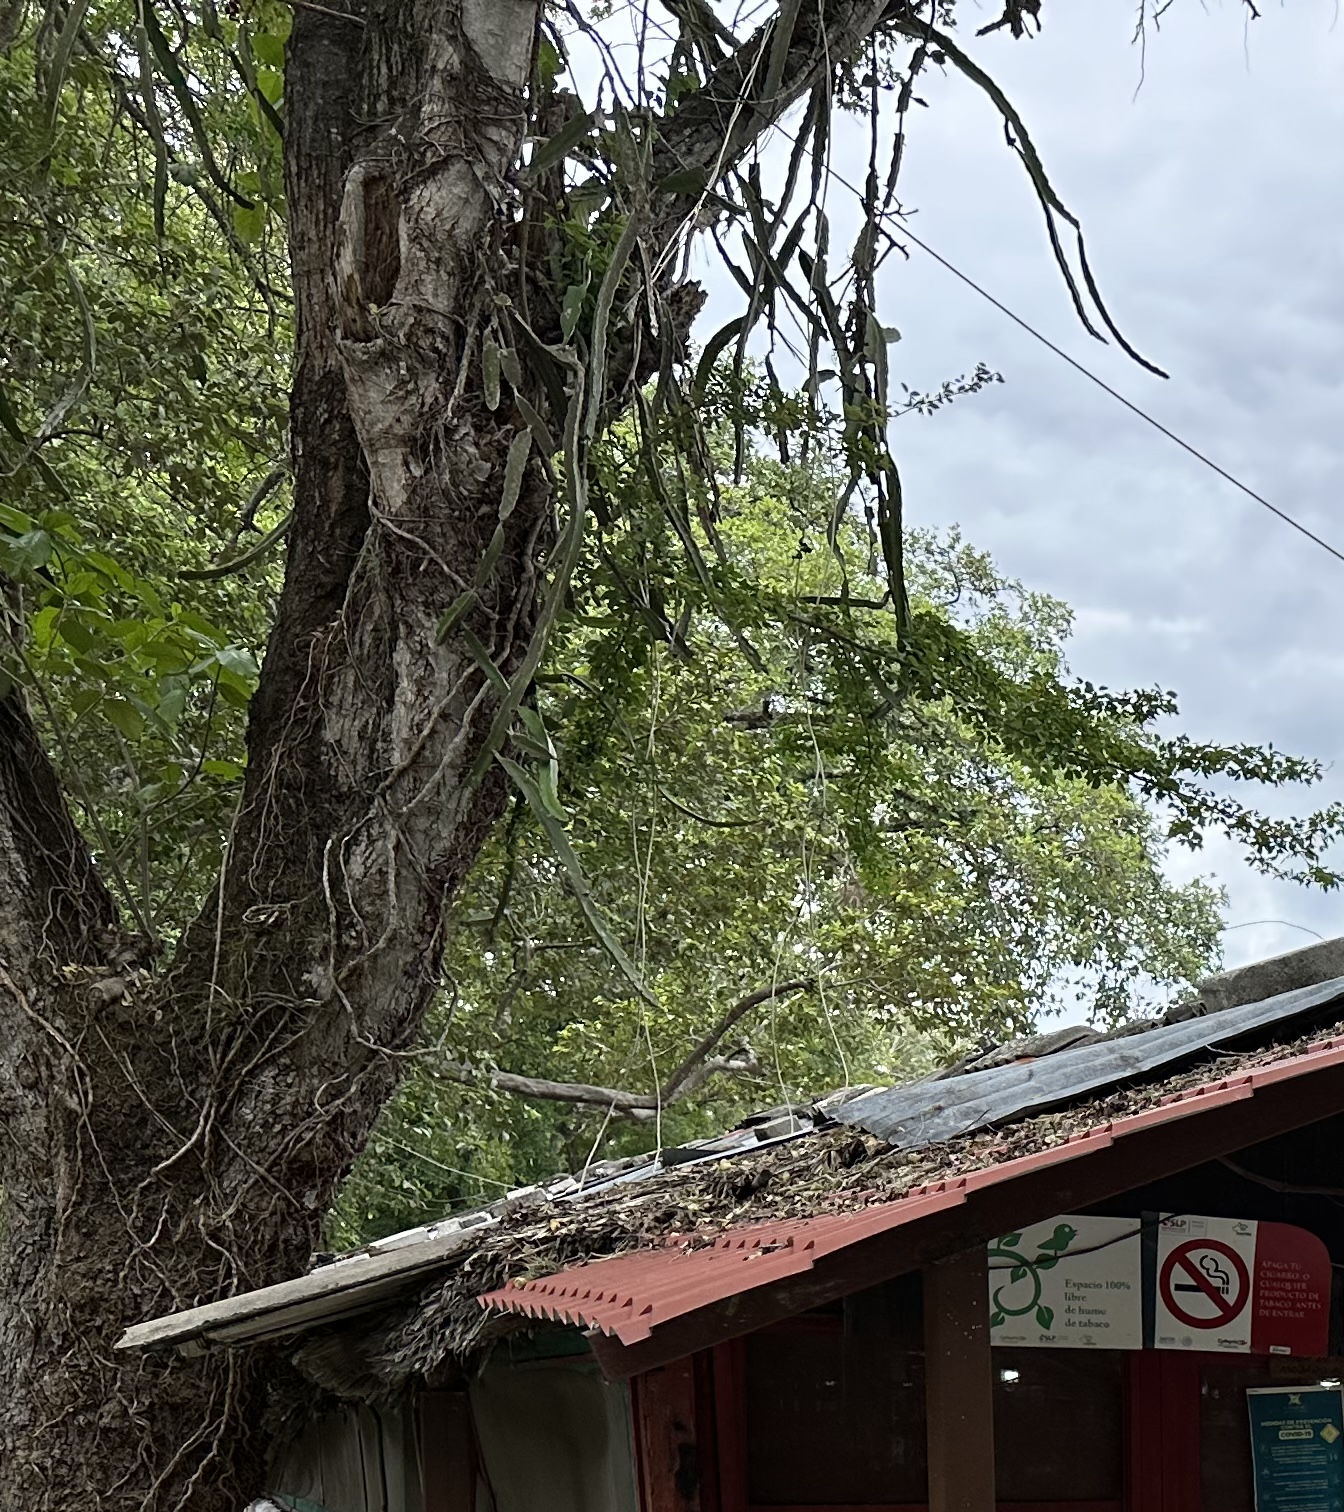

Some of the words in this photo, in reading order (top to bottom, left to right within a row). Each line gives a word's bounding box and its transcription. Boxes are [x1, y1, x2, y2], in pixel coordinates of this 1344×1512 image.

[1261, 1261, 1289, 1269] APAGA
[1290, 1262, 1300, 1270] TU
[1260, 1270, 1299, 1279] CIGARRO
[1065, 1279, 1103, 1291] Espacio
[1105, 1281, 1131, 1290] 100%
[1260, 1280, 1307, 1290] CUALQUIER
[1064, 1292, 1087, 1301] libre
[1260, 1290, 1307, 1299] PRODUCTO
[1308, 1292, 1319, 1300] DE
[1260, 1300, 1292, 1308] TABACO
[1065, 1305, 1076, 1314] de
[1078, 1306, 1106, 1315] humo
[1260, 1309, 1270, 1317] DE
[1272, 1310, 1305, 1318] ENTRAR
[1065, 1318, 1076, 1327] de
[1079, 1318, 1111, 1328] tabaco
